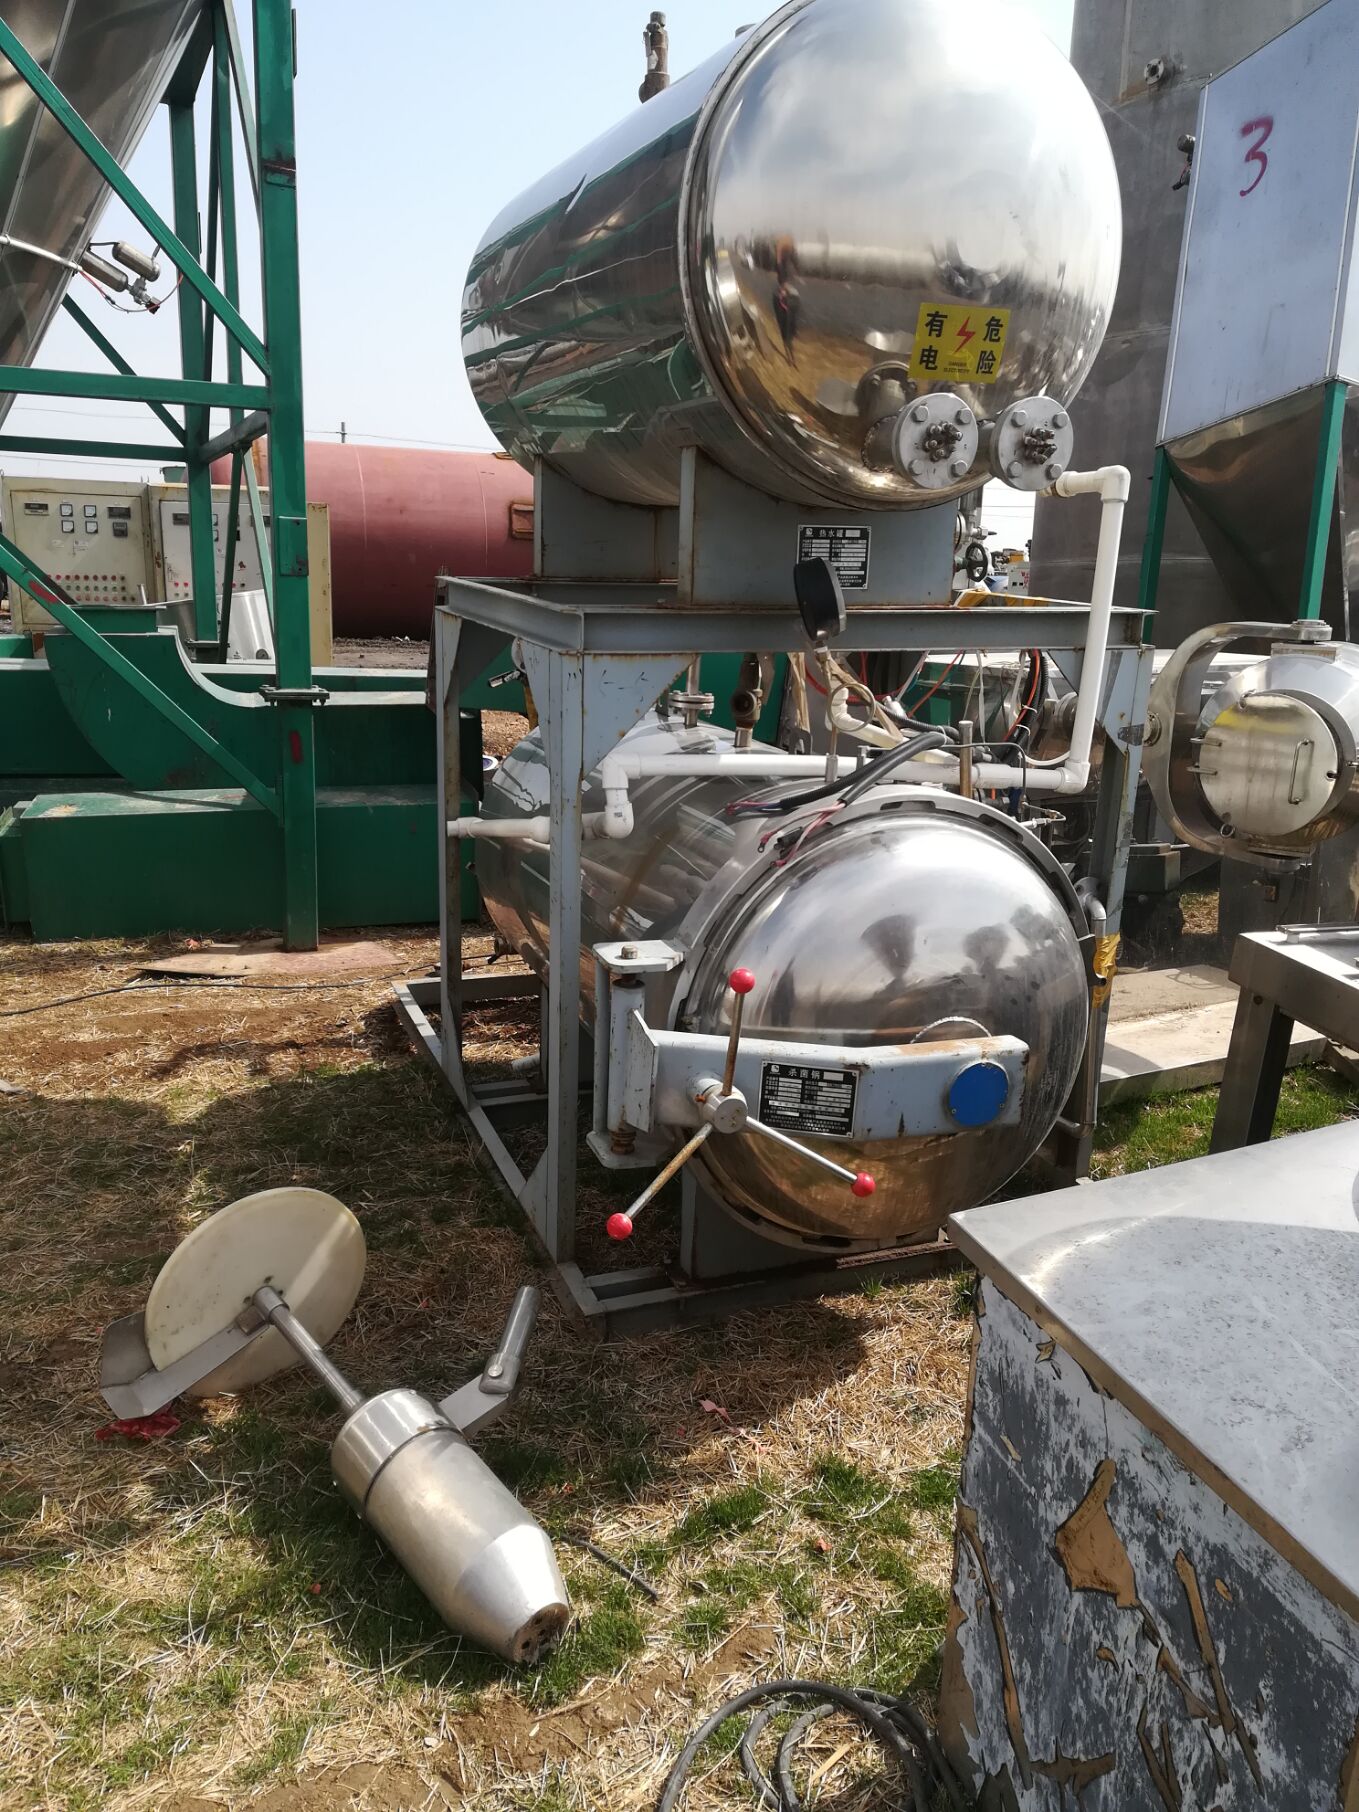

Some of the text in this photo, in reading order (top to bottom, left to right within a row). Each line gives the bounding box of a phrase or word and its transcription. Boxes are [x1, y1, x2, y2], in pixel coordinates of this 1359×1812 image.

[1239, 116, 1273, 197] 3
[919, 311, 948, 370] 有电
[975, 316, 1003, 374] 危险
[788, 1068, 821, 1080] 杀菌锅
